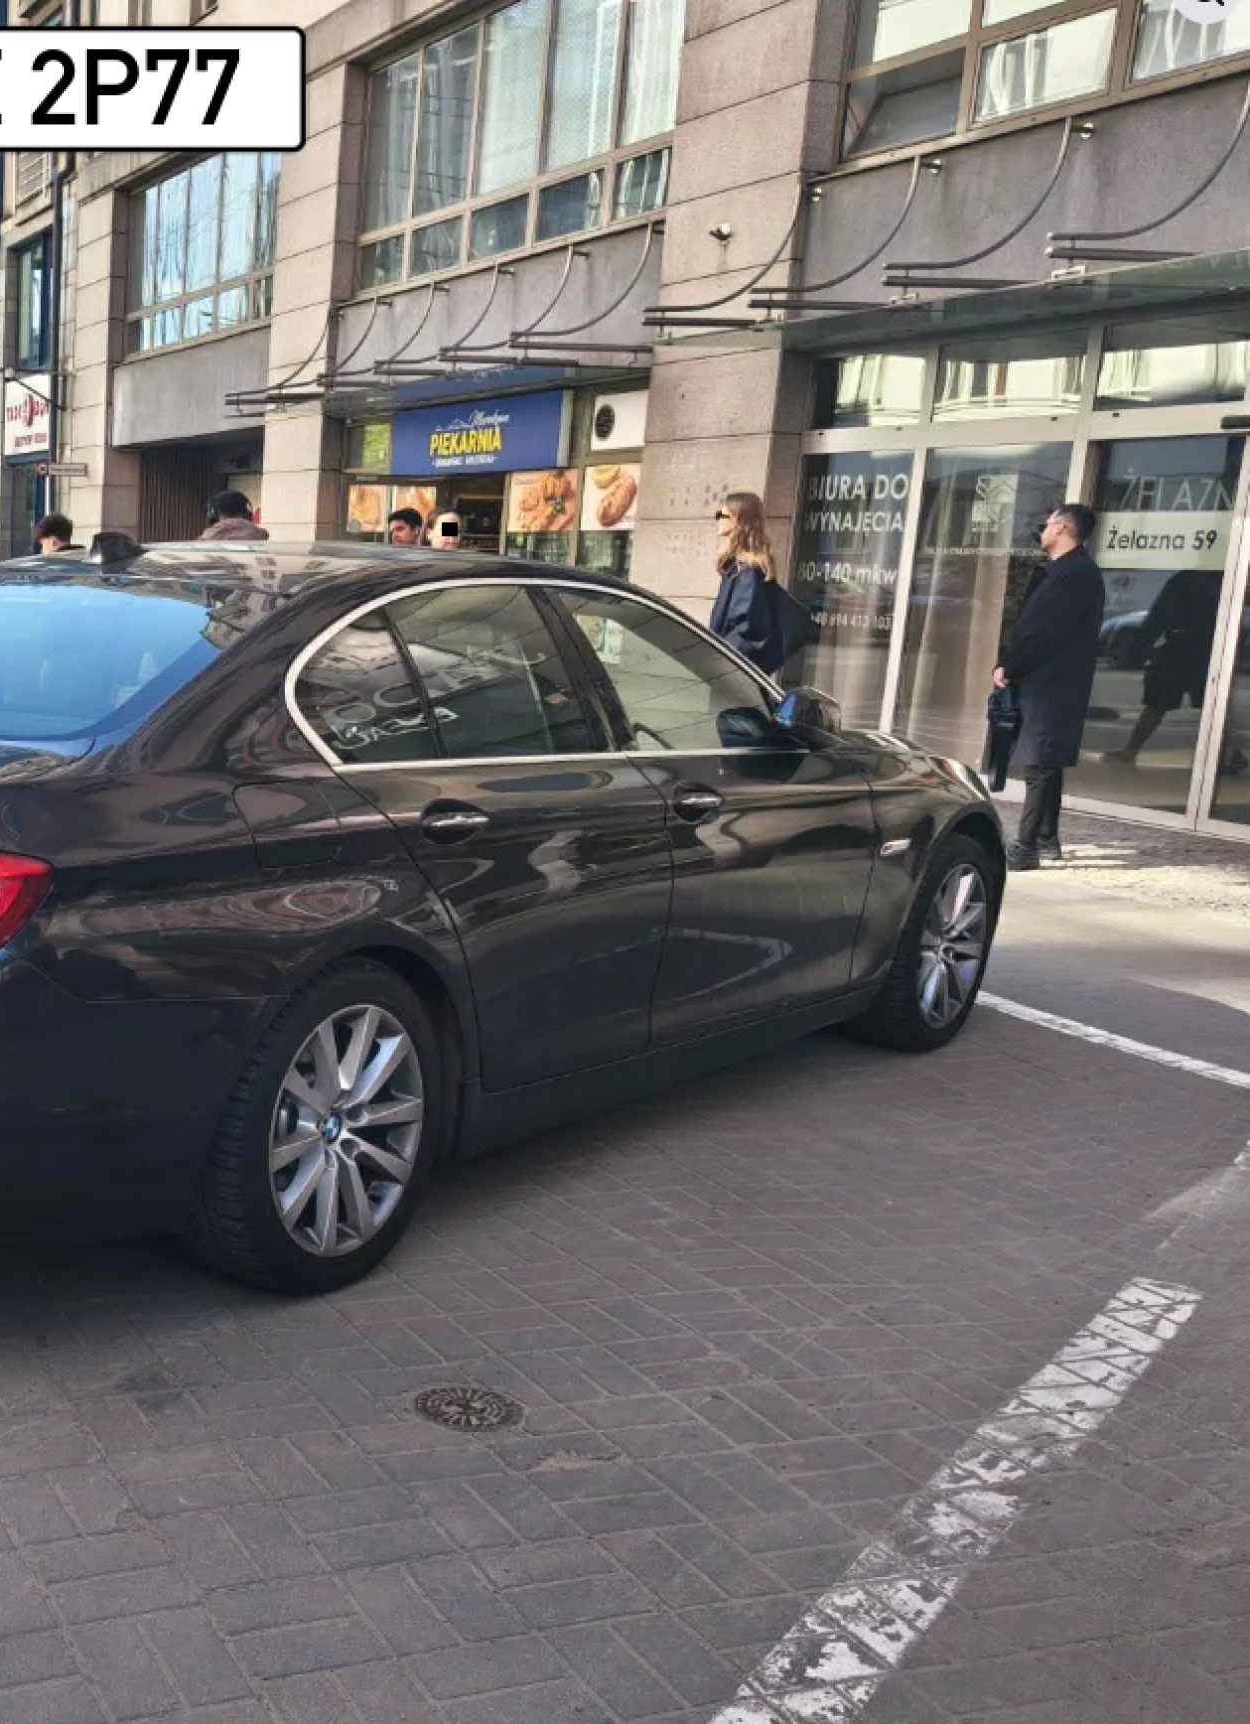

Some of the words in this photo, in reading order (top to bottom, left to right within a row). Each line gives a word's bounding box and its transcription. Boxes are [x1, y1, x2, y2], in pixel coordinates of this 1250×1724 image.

[430, 426, 502, 456] PIEKARNIA
[809, 474, 866, 500] BIURA
[875, 473, 909, 499] DO
[805, 511, 904, 536] WYNAJĘCIA
[1107, 524, 1185, 550] Żelazna
[1192, 530, 1218, 550] 59
